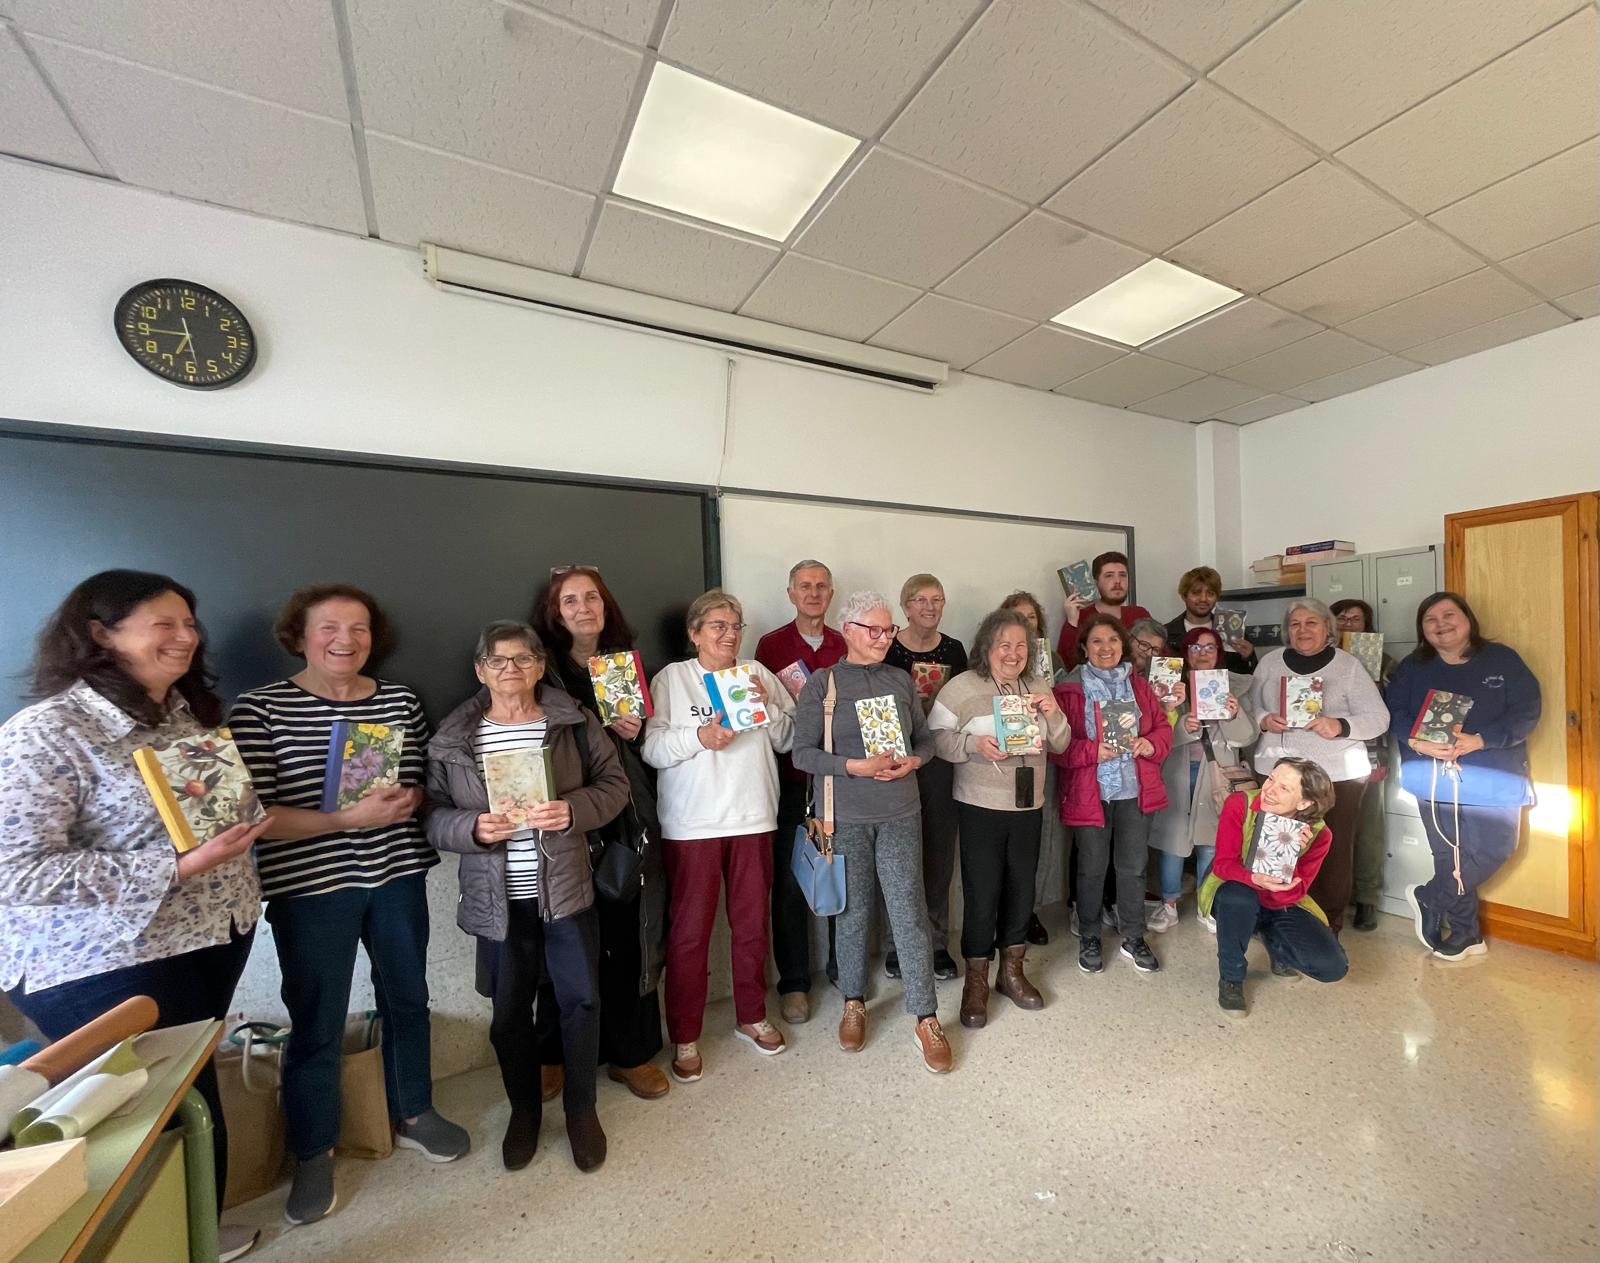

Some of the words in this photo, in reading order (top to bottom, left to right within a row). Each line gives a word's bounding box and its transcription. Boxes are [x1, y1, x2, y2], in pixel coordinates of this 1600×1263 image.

[157, 297, 170, 311] 11
[180, 297, 196, 310] 12
[140, 306, 157, 320] 10
[138, 322, 150, 336] 9
[220, 318, 230, 332] 2
[146, 340, 158, 354] 8
[226, 336, 238, 348] 3
[162, 353, 174, 366] 7
[222, 352, 232, 364] 4
[185, 361, 196, 374] 6
[207, 360, 218, 372] 5
